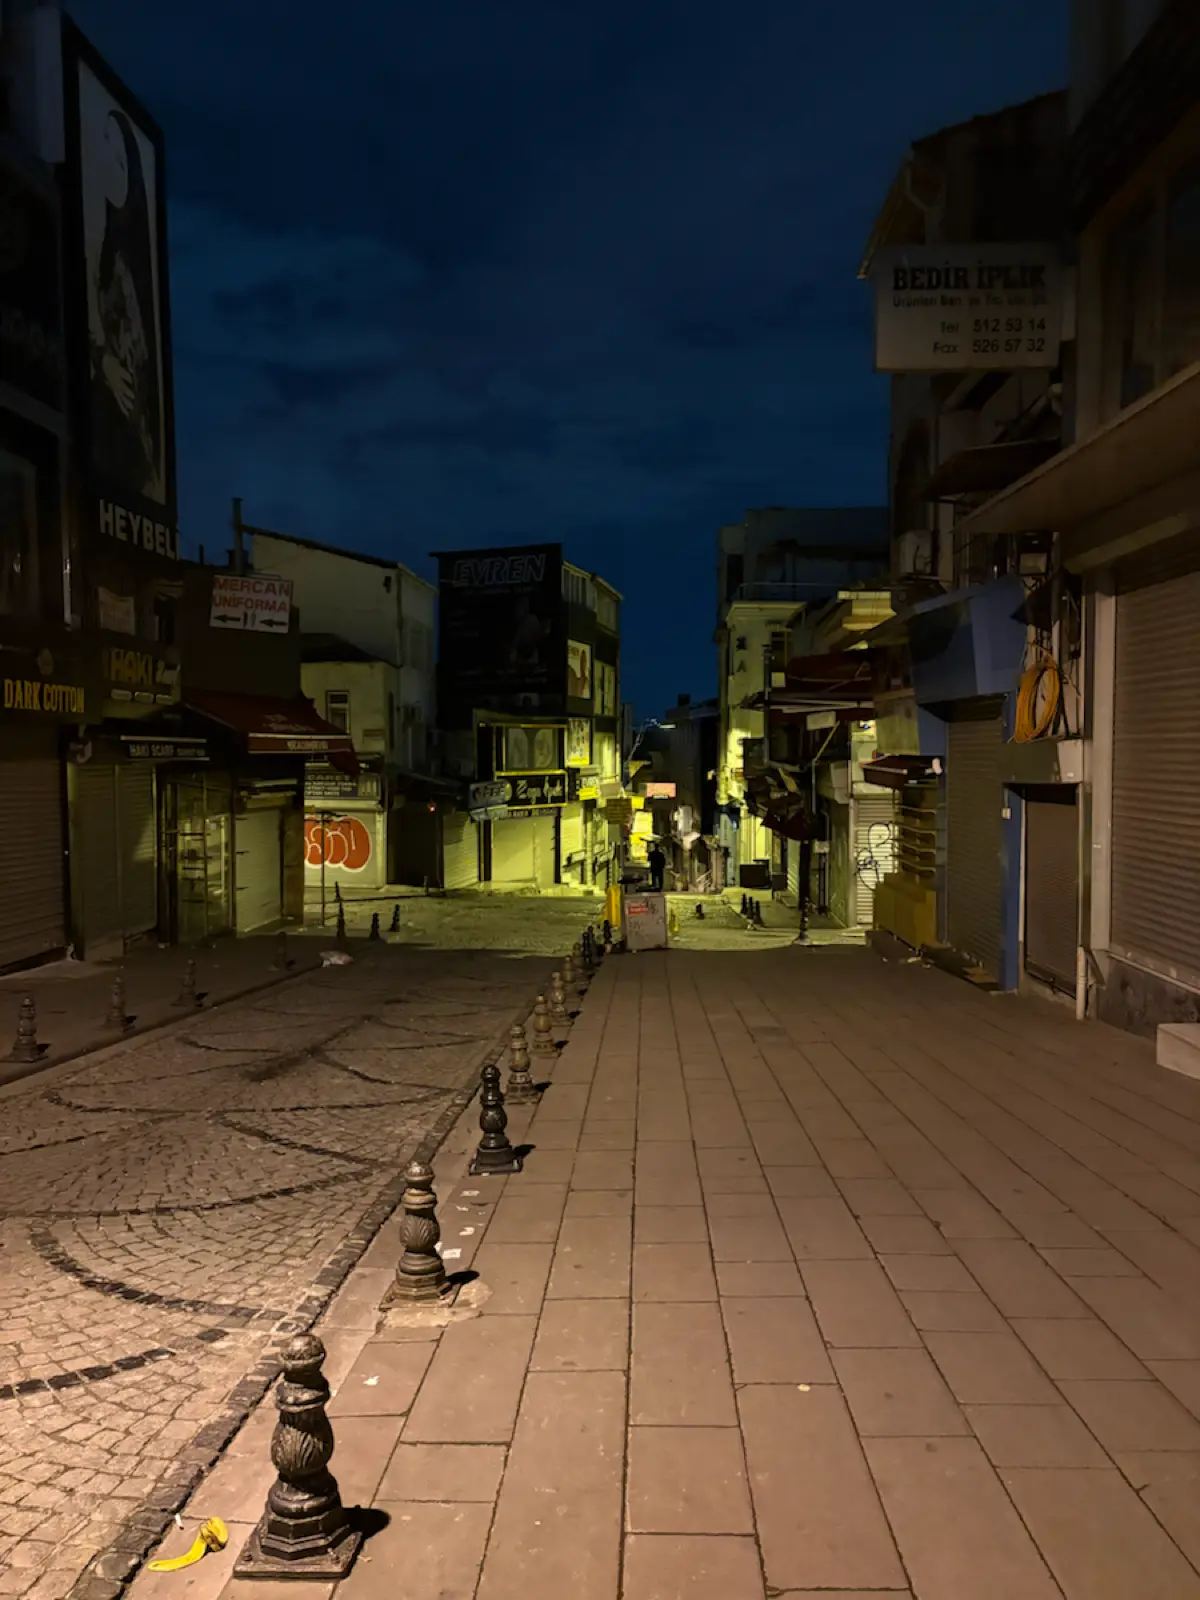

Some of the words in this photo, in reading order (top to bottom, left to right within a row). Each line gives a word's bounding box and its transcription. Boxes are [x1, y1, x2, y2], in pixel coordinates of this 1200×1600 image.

[893, 260, 970, 290] BEDİR
[973, 318, 1001, 333] 512
[1028, 318, 1047, 332] 14
[933, 342, 960, 355] Fax
[972, 339, 1000, 353] 526
[1004, 338, 1022, 353] 57
[1027, 337, 1046, 352] 32
[452, 553, 547, 589] EVREN
[213, 578, 290, 597] MERCAN
[4, 678, 42, 711] DARK
[43, 683, 86, 713] COTTON
